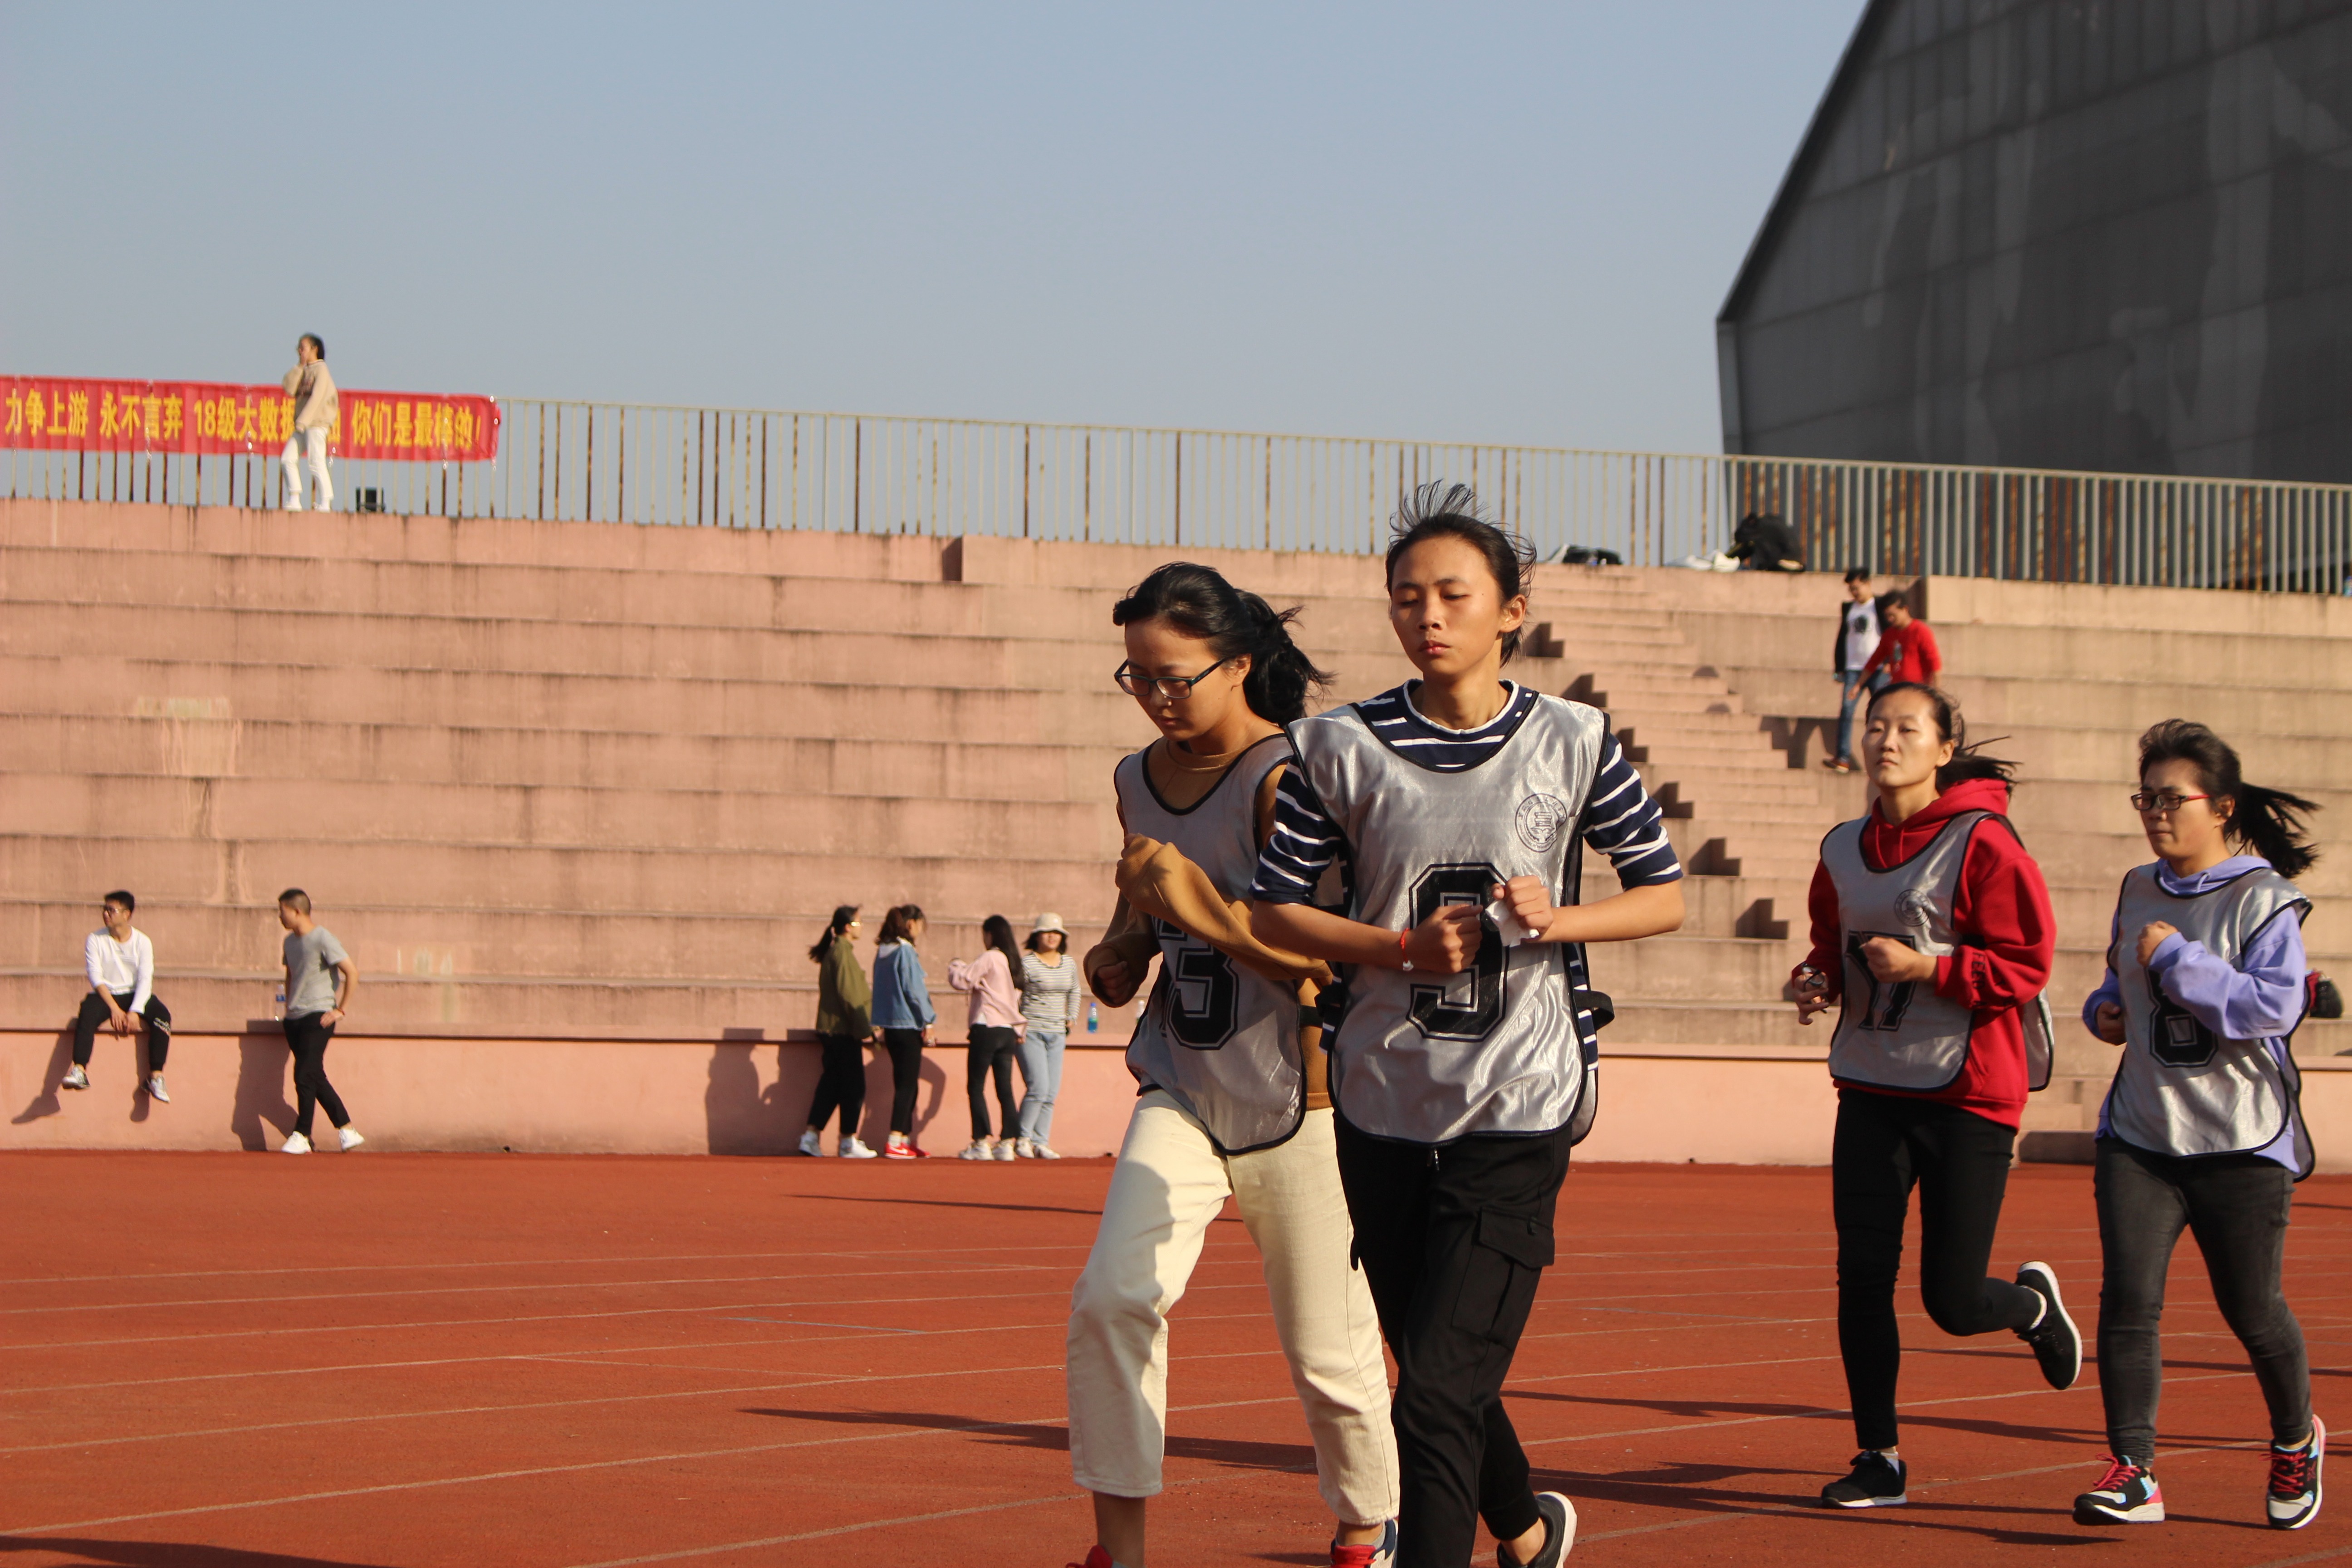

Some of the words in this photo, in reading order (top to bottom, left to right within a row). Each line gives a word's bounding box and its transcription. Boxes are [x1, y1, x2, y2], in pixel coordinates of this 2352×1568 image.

[5, 387, 89, 438] 力争上游
[99, 390, 183, 441] 永不言弃
[194, 394, 341, 445] 18级大数据
[1406, 862, 1510, 1042] 9
